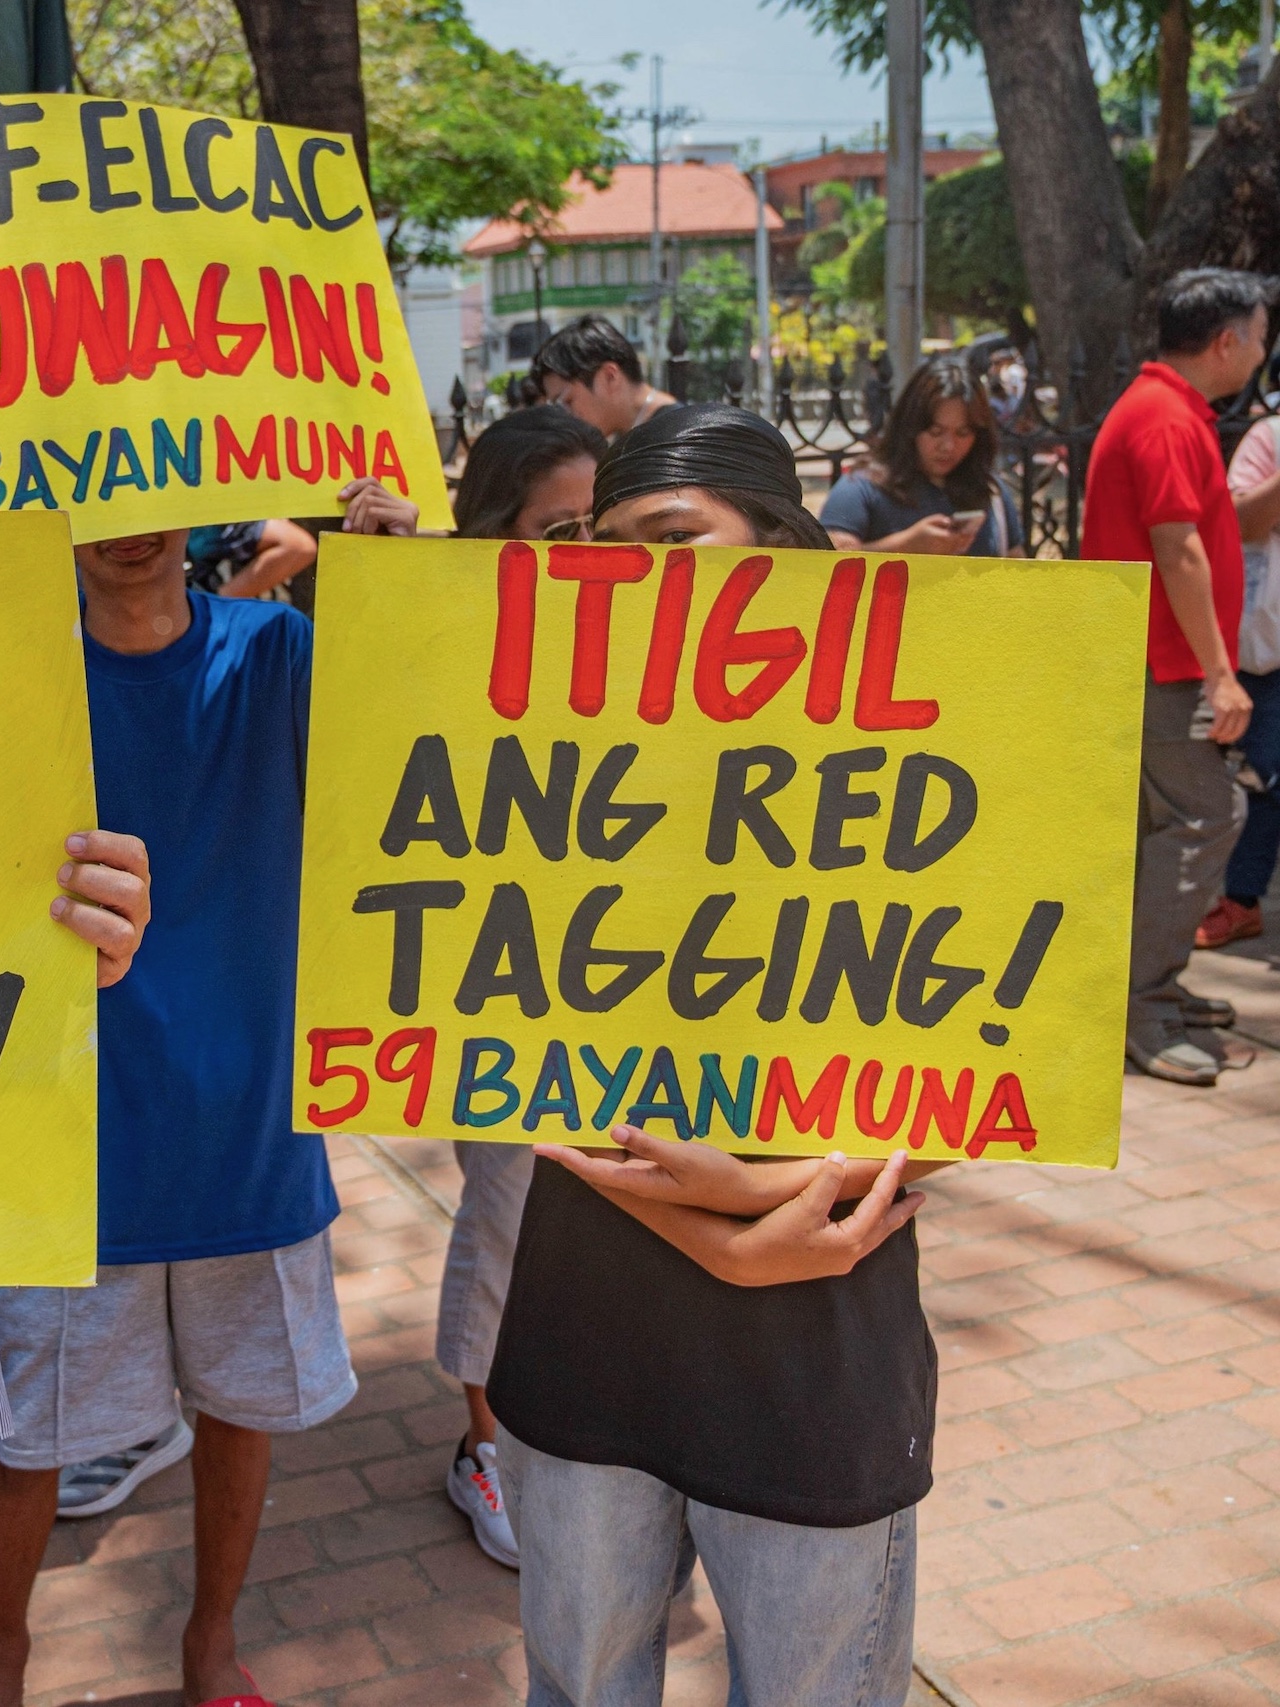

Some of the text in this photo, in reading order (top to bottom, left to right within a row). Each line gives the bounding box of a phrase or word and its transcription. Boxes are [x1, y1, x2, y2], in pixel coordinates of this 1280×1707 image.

[214, 414, 410, 498] MUNA
[486, 541, 940, 731] ITIGIL
[380, 734, 978, 872] ANG RED
[351, 880, 1065, 1047] TAGGING!
[306, 1027, 1038, 1159] 59 BAYAN MUNA
